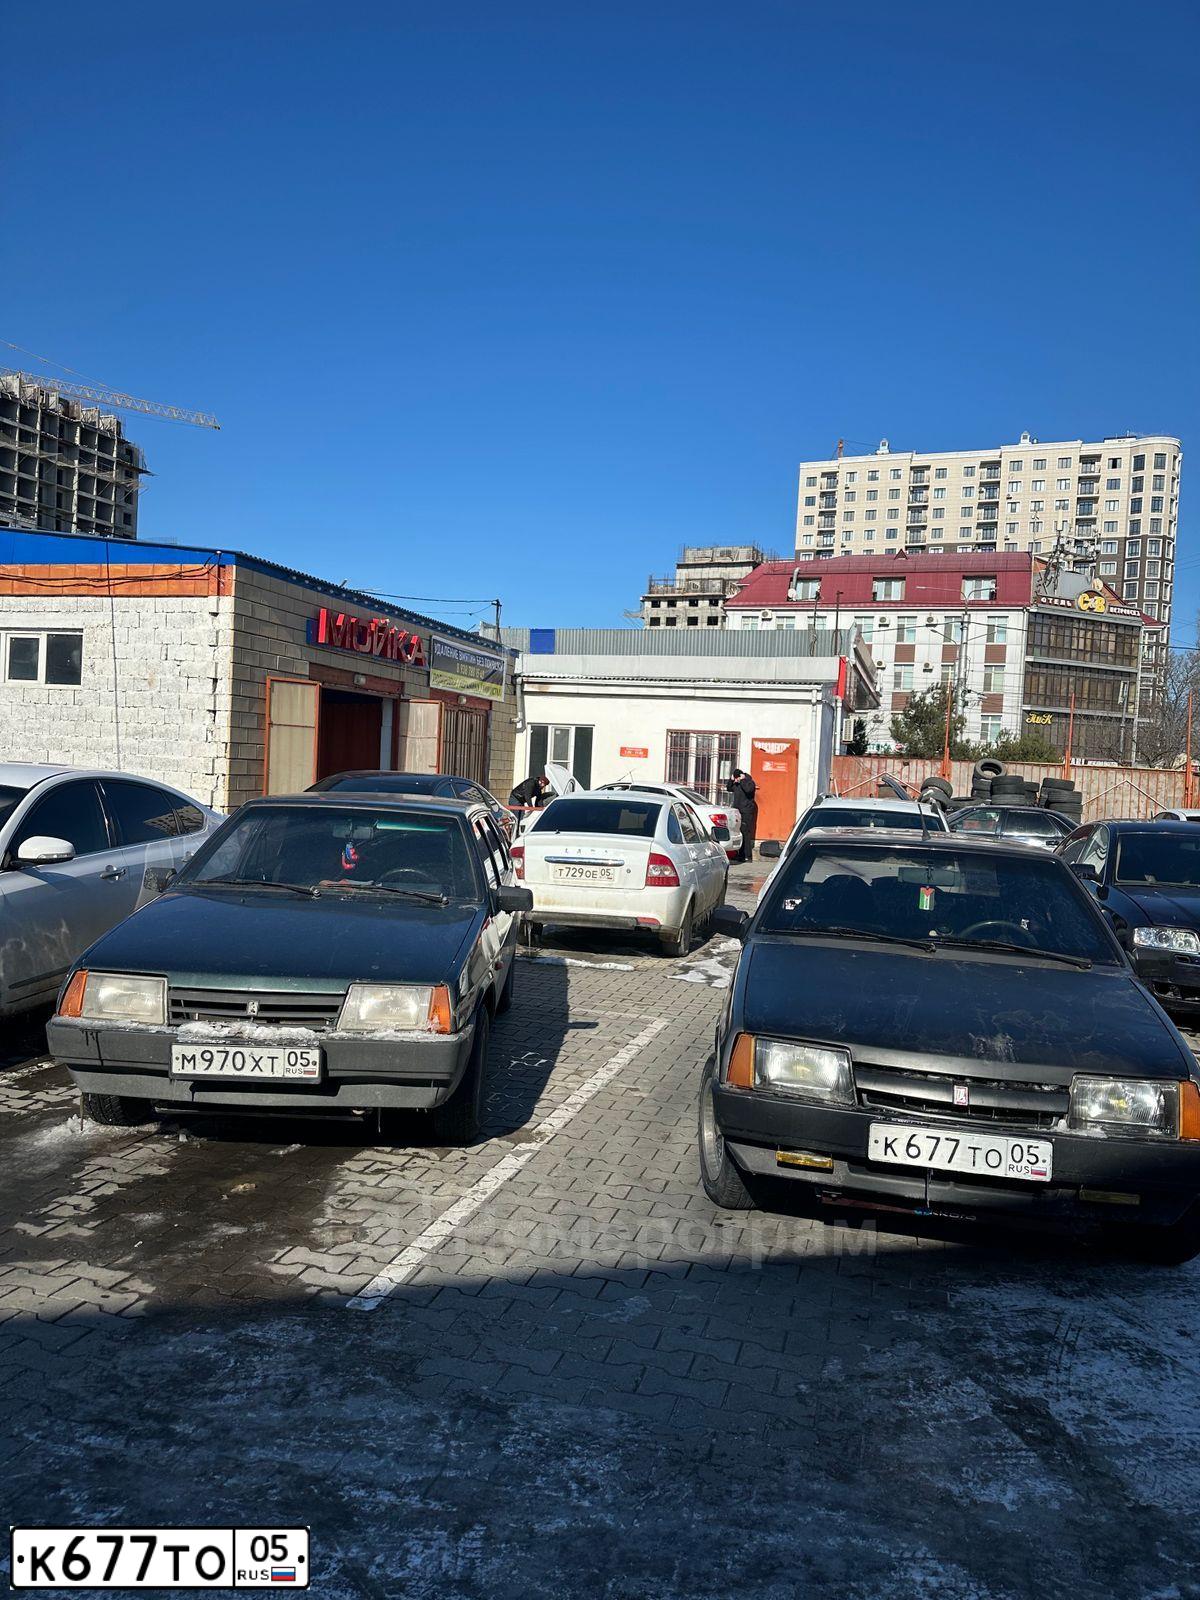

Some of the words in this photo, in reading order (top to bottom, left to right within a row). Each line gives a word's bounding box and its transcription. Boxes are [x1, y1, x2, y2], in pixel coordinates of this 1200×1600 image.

[318, 608, 427, 667] МОЙКА
[600, 868, 611, 877] 05
[181, 1050, 279, 1073] М970ХТ
[287, 1051, 311, 1067] 05
[285, 1067, 303, 1075] RUS
[884, 1133, 1003, 1169] К677ТО
[1010, 1143, 1040, 1165] 05
[1008, 1164, 1030, 1174] RUS
